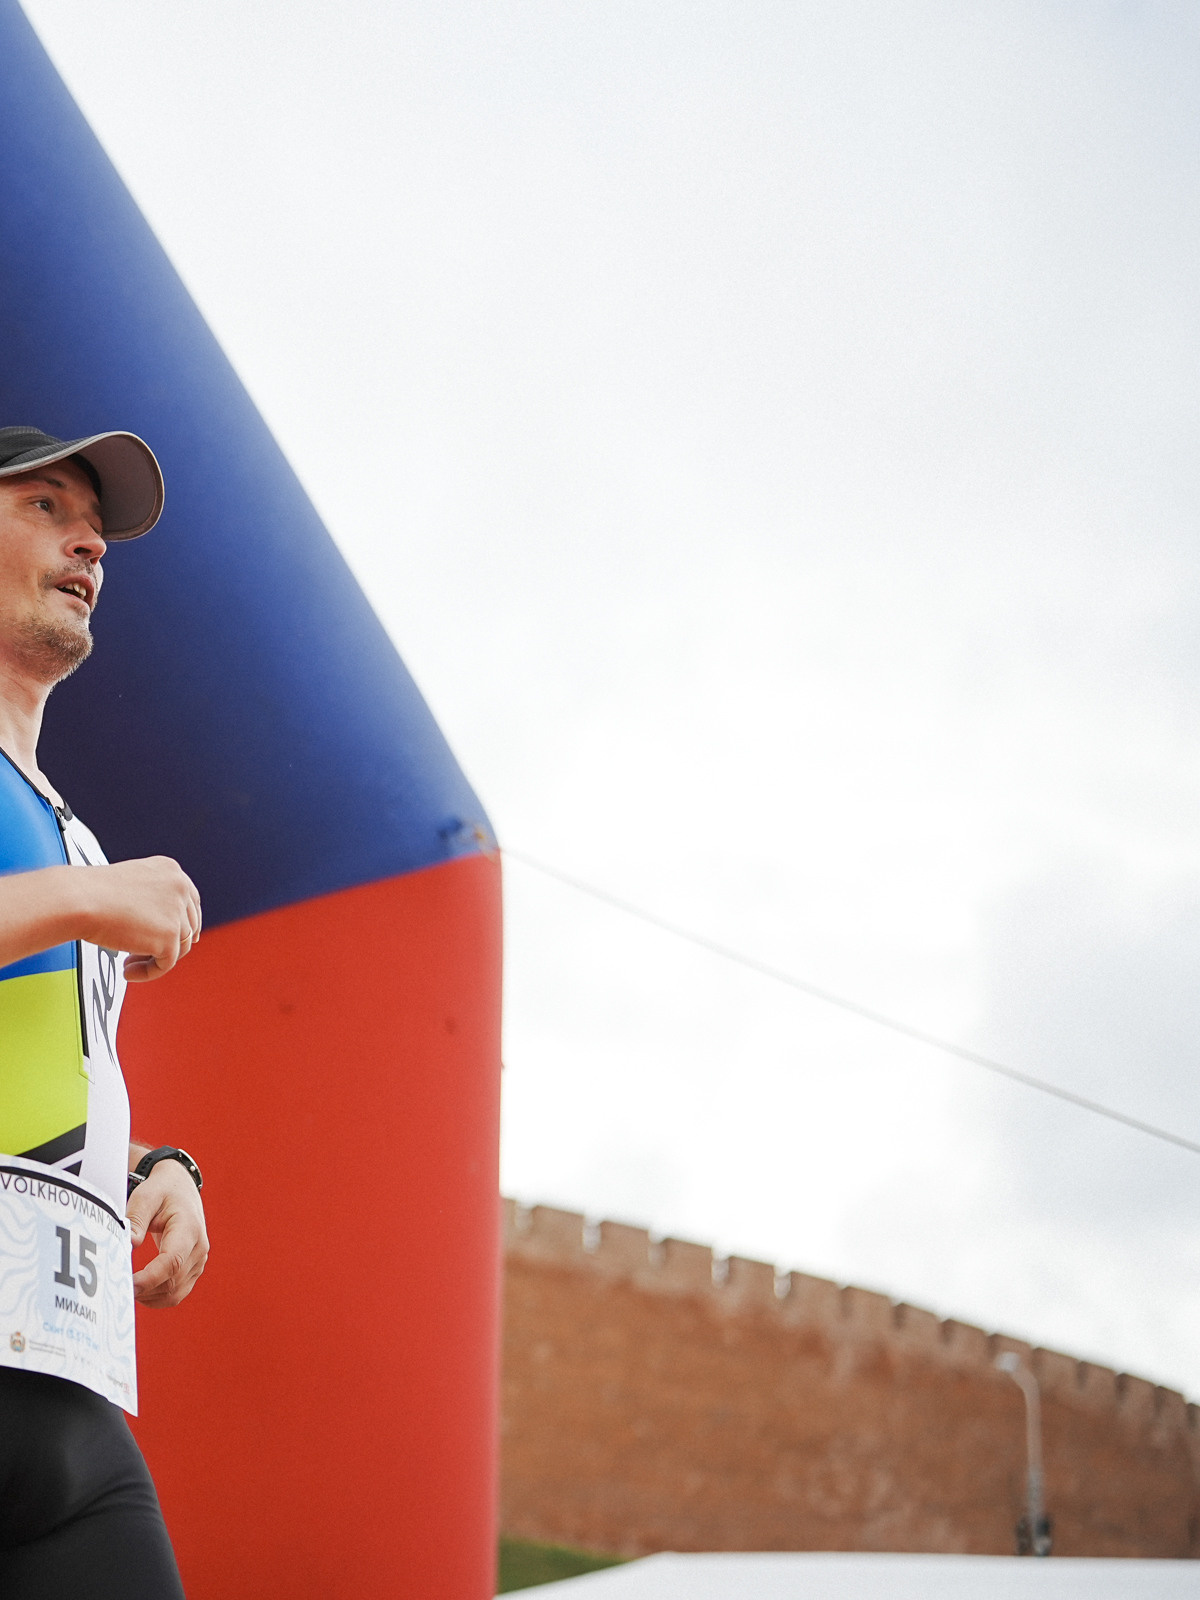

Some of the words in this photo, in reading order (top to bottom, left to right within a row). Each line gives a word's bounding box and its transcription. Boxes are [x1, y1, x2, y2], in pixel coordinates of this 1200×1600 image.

[0, 1173, 104, 1226] VOLKHOVMAN
[54, 1225, 97, 1298] 15
[55, 1295, 97, 1324] МИХАИЛ
